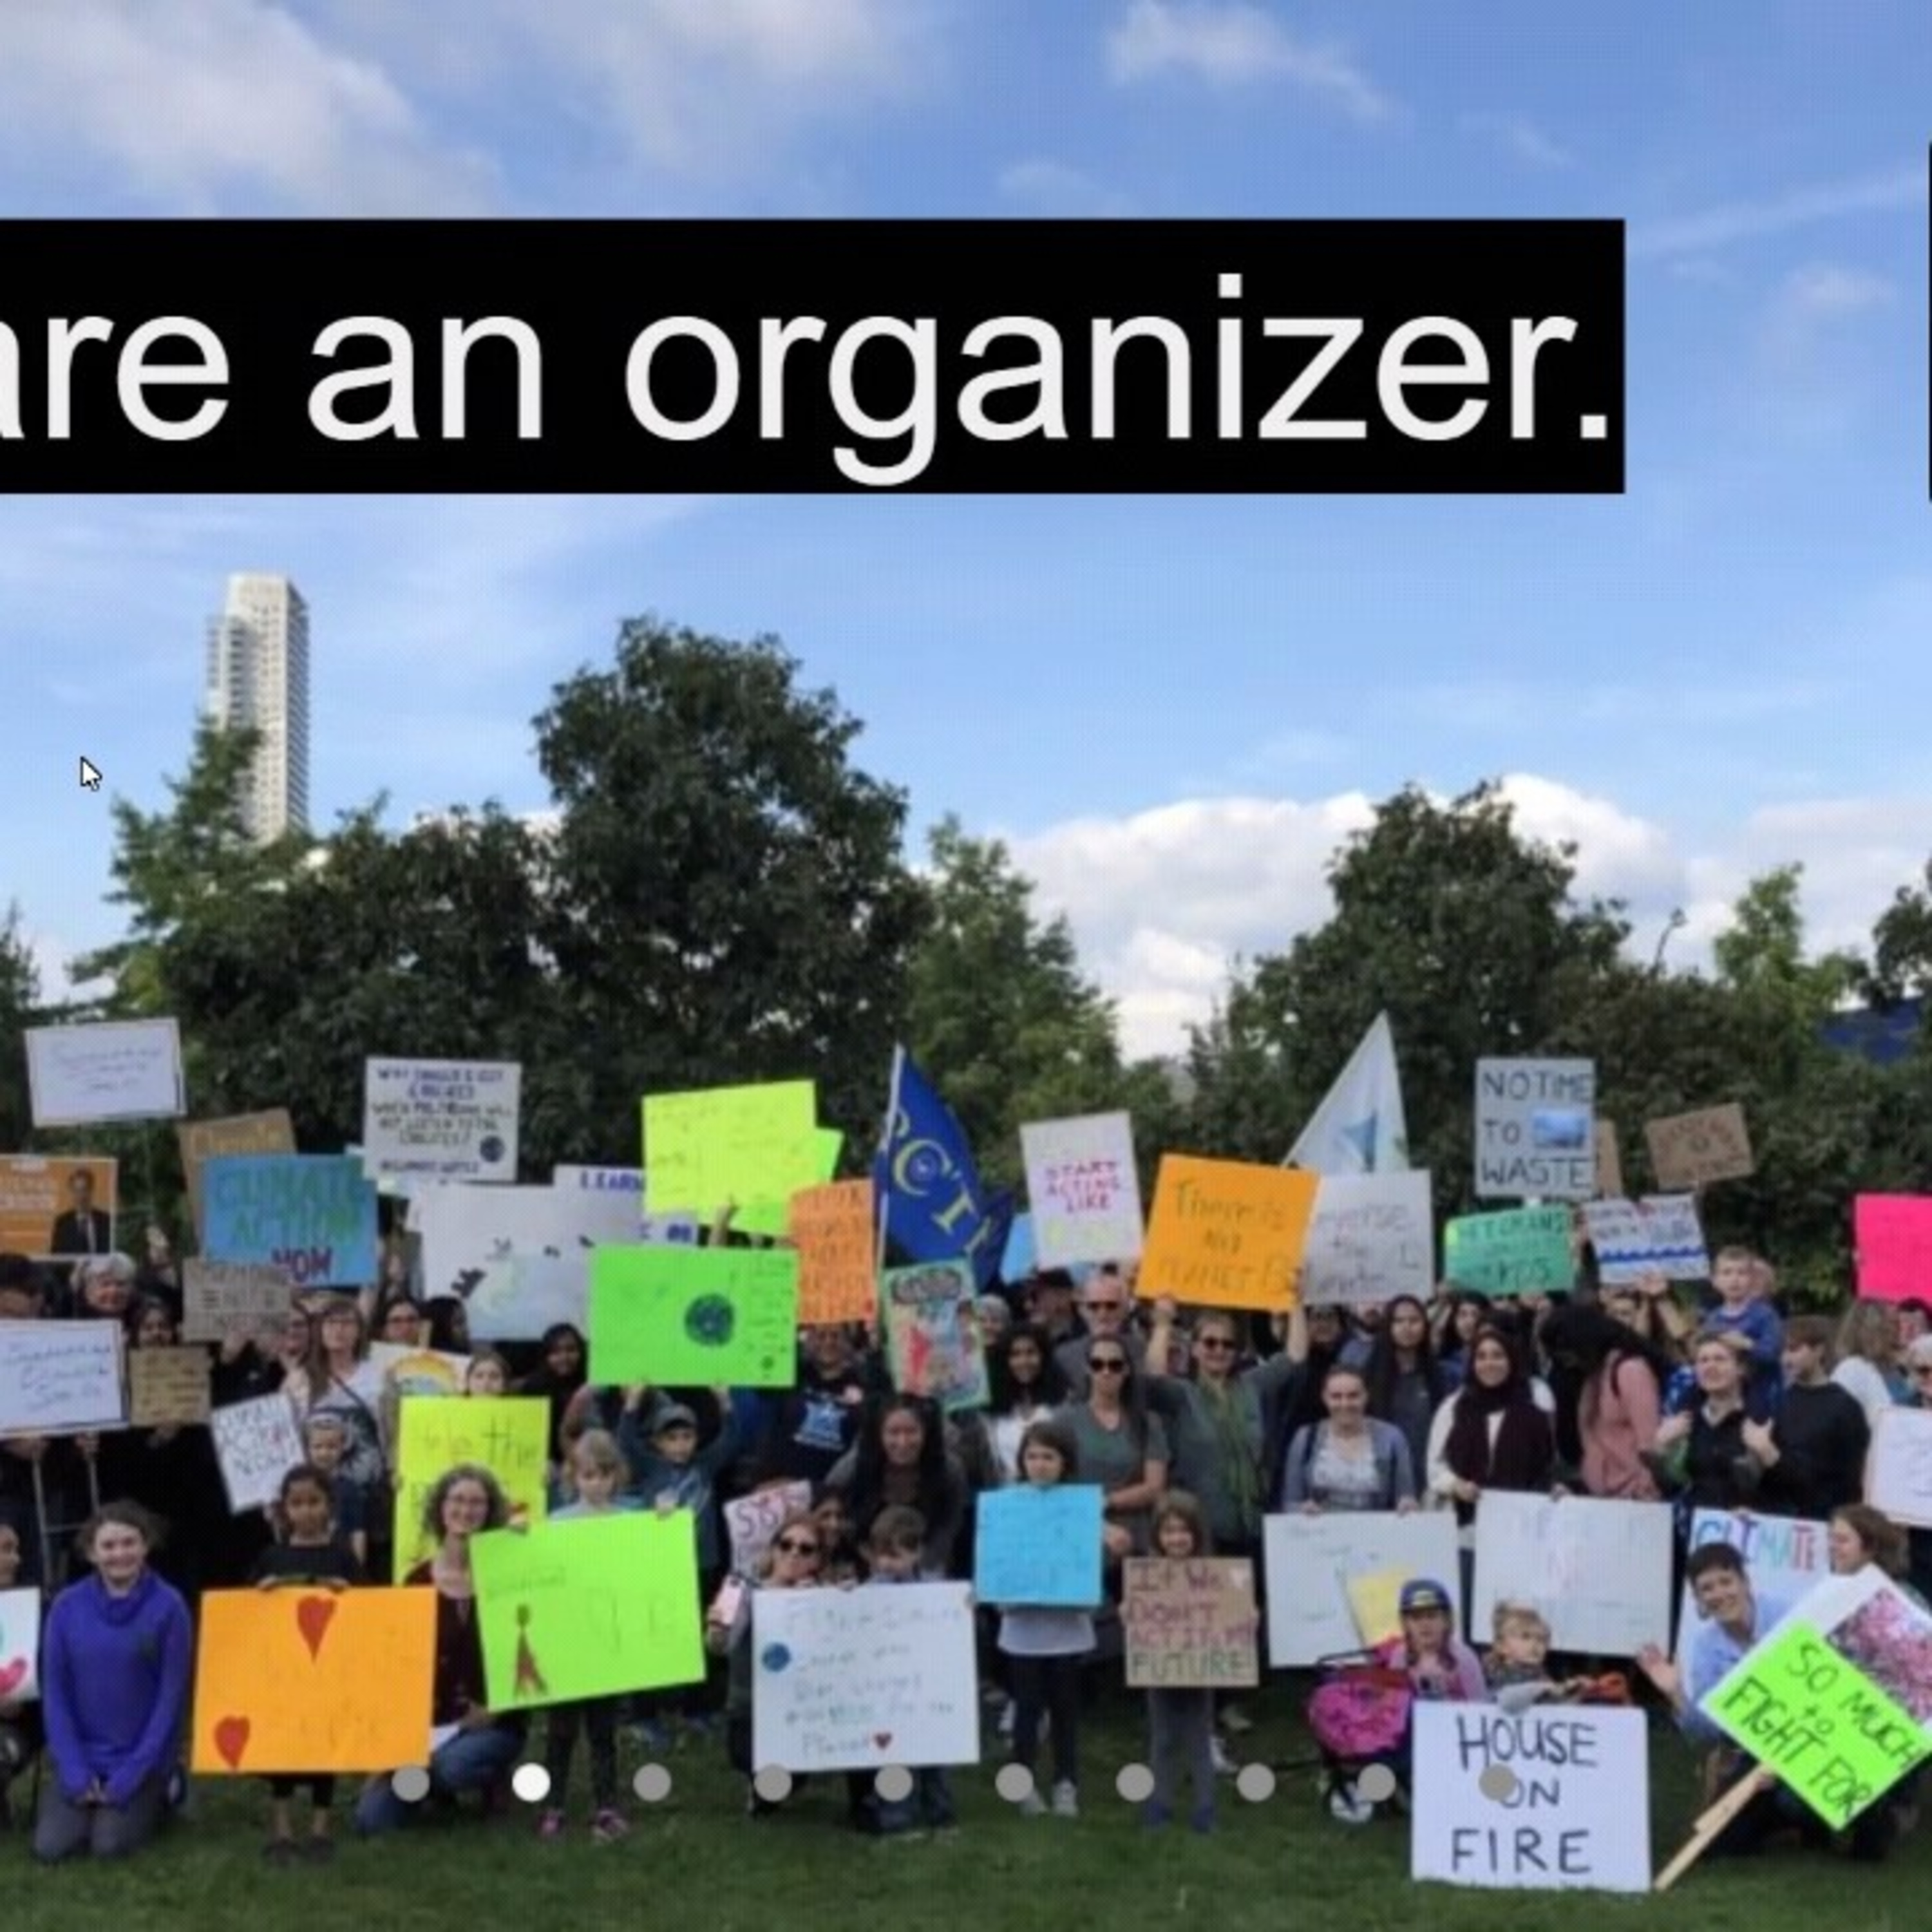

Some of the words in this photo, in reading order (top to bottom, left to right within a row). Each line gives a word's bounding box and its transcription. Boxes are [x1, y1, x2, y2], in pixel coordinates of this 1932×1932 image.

[1483, 1119, 1520, 1146] TO
[1482, 1157, 1592, 1189] WASTE
[1785, 1643, 1839, 1694] SO
[1837, 1690, 1922, 1770] MUCH
[1799, 1705, 1835, 1736] to
[1456, 1712, 1599, 1771] HOUSE
[1723, 1675, 1828, 1764] FIGHT
[1806, 1756, 1873, 1819] FOR
[1451, 1825, 1593, 1873] FIRE
